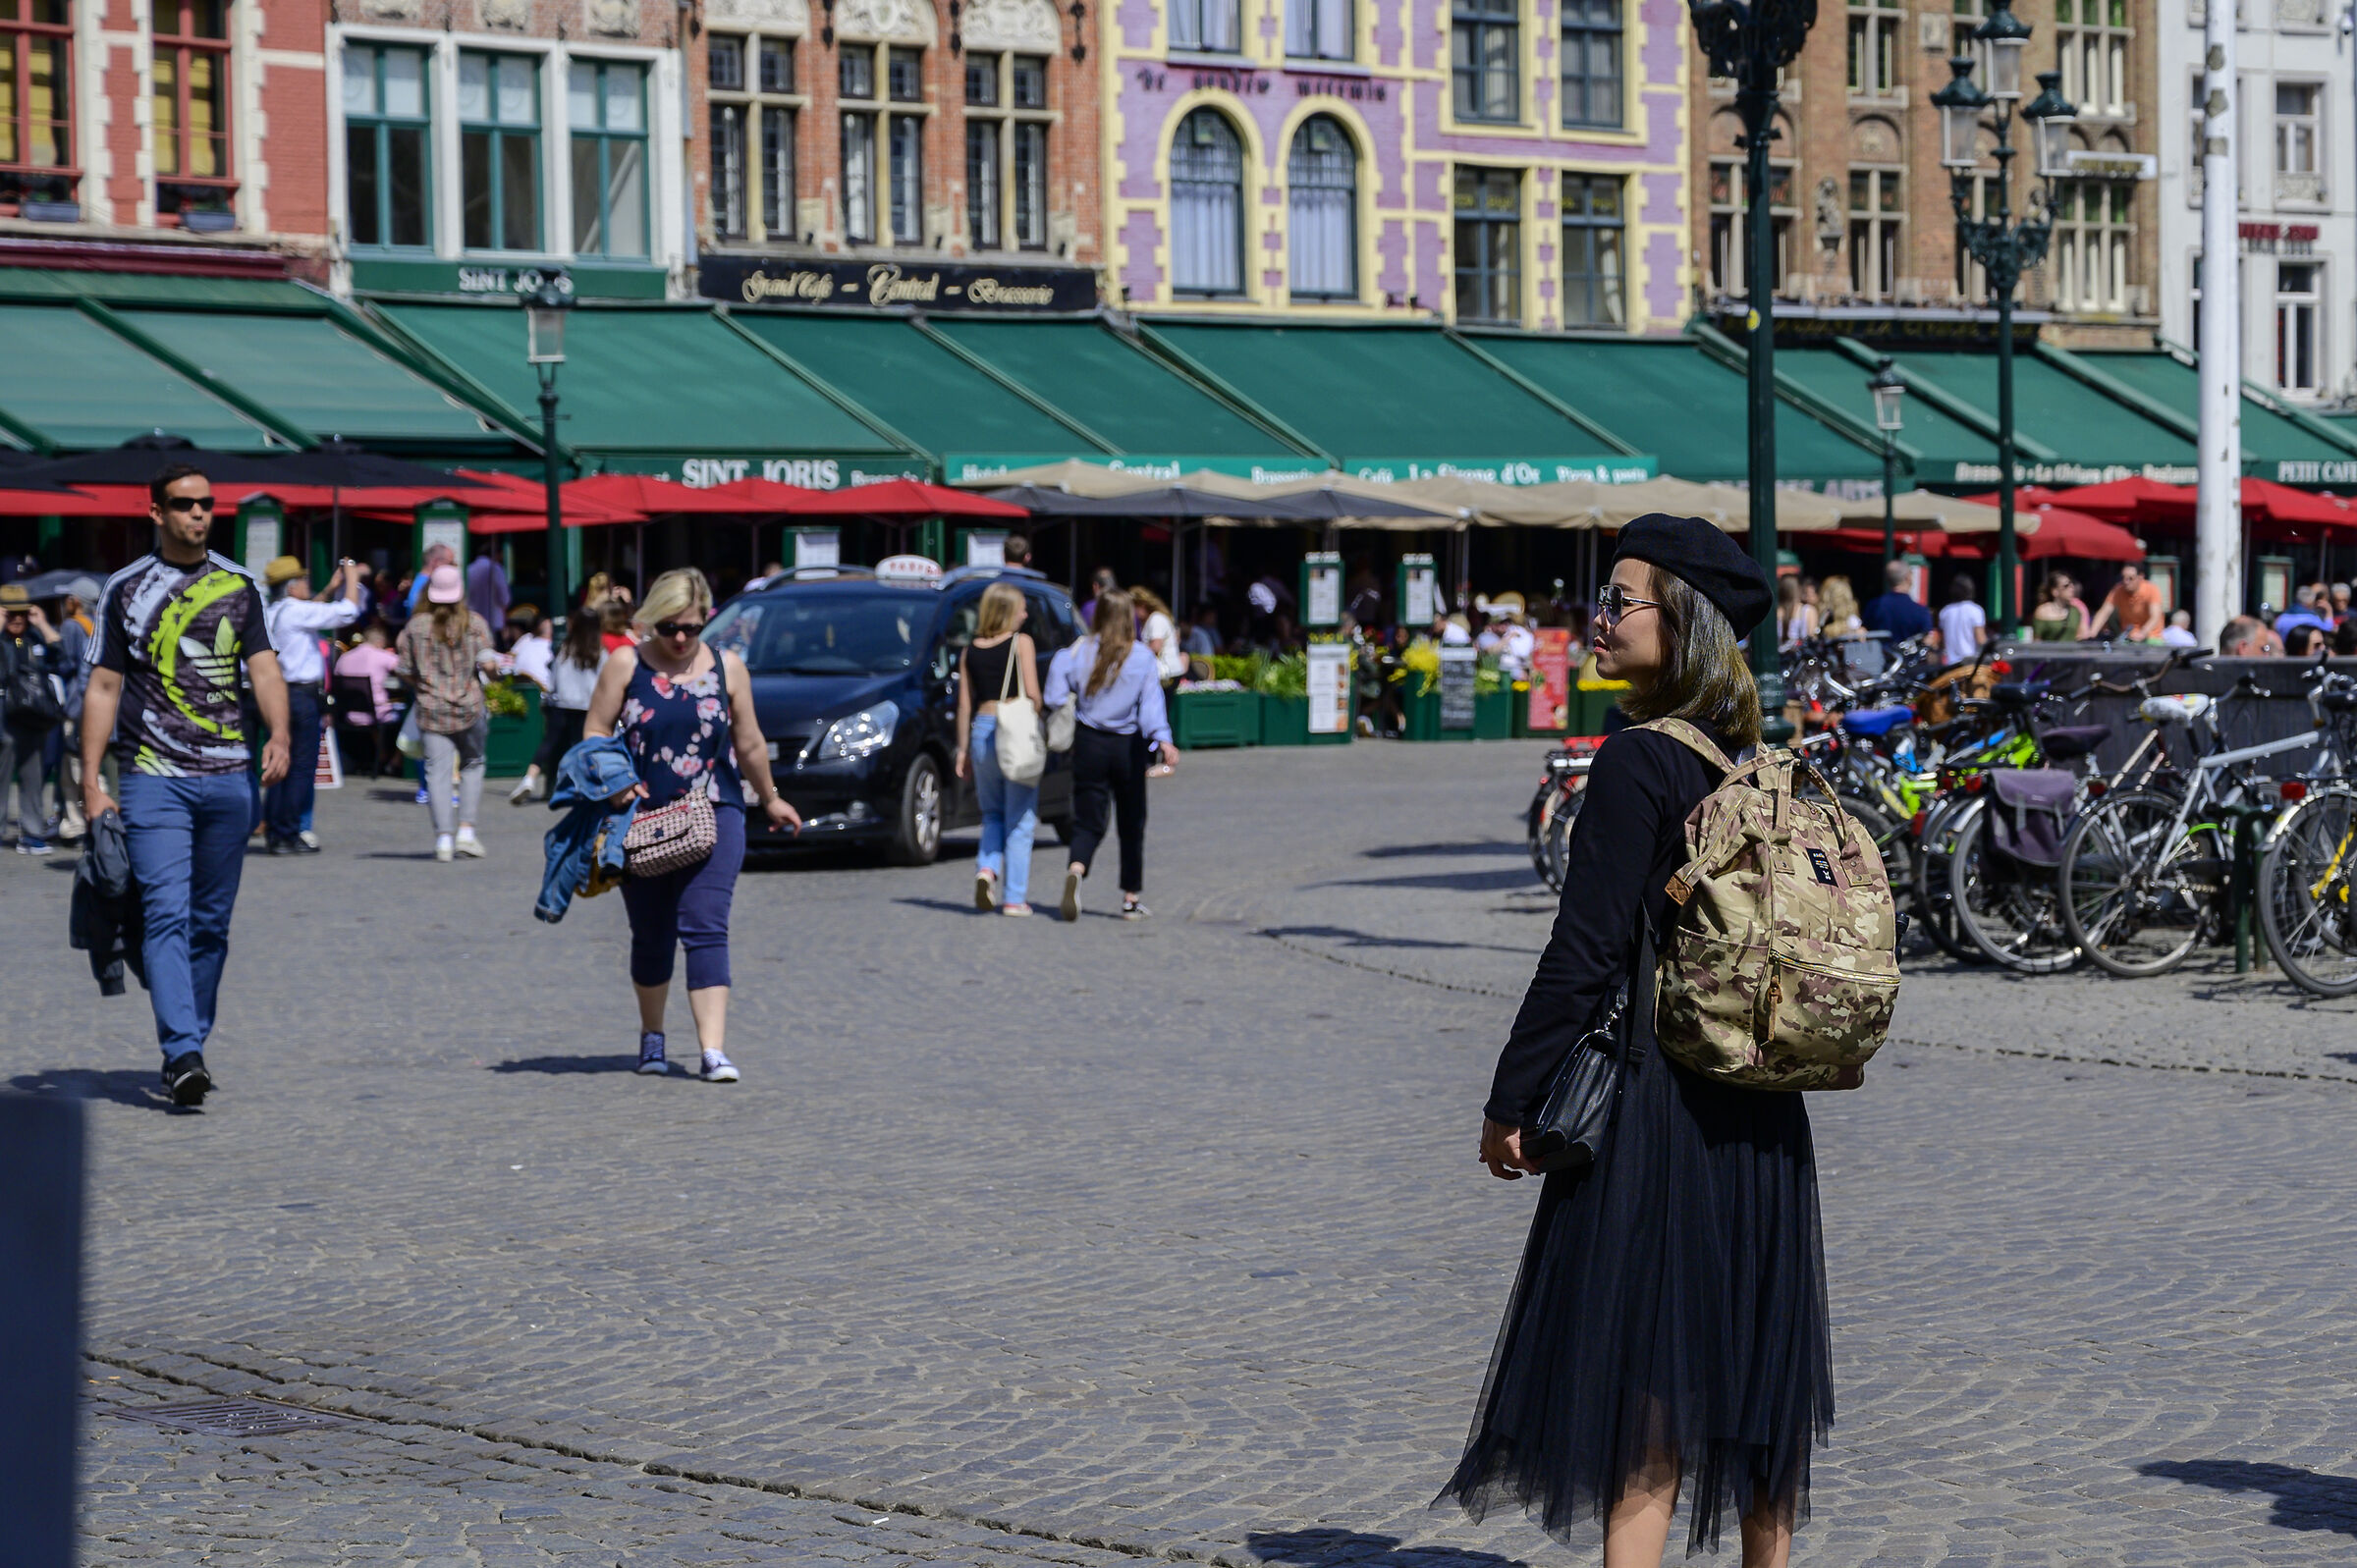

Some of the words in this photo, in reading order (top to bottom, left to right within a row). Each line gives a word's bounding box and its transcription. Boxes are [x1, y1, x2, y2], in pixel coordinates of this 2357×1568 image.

[459, 267, 508, 293] SINT
[513, 269, 575, 295] JOS
[866, 264, 940, 306] Central
[683, 459, 749, 489] SINT
